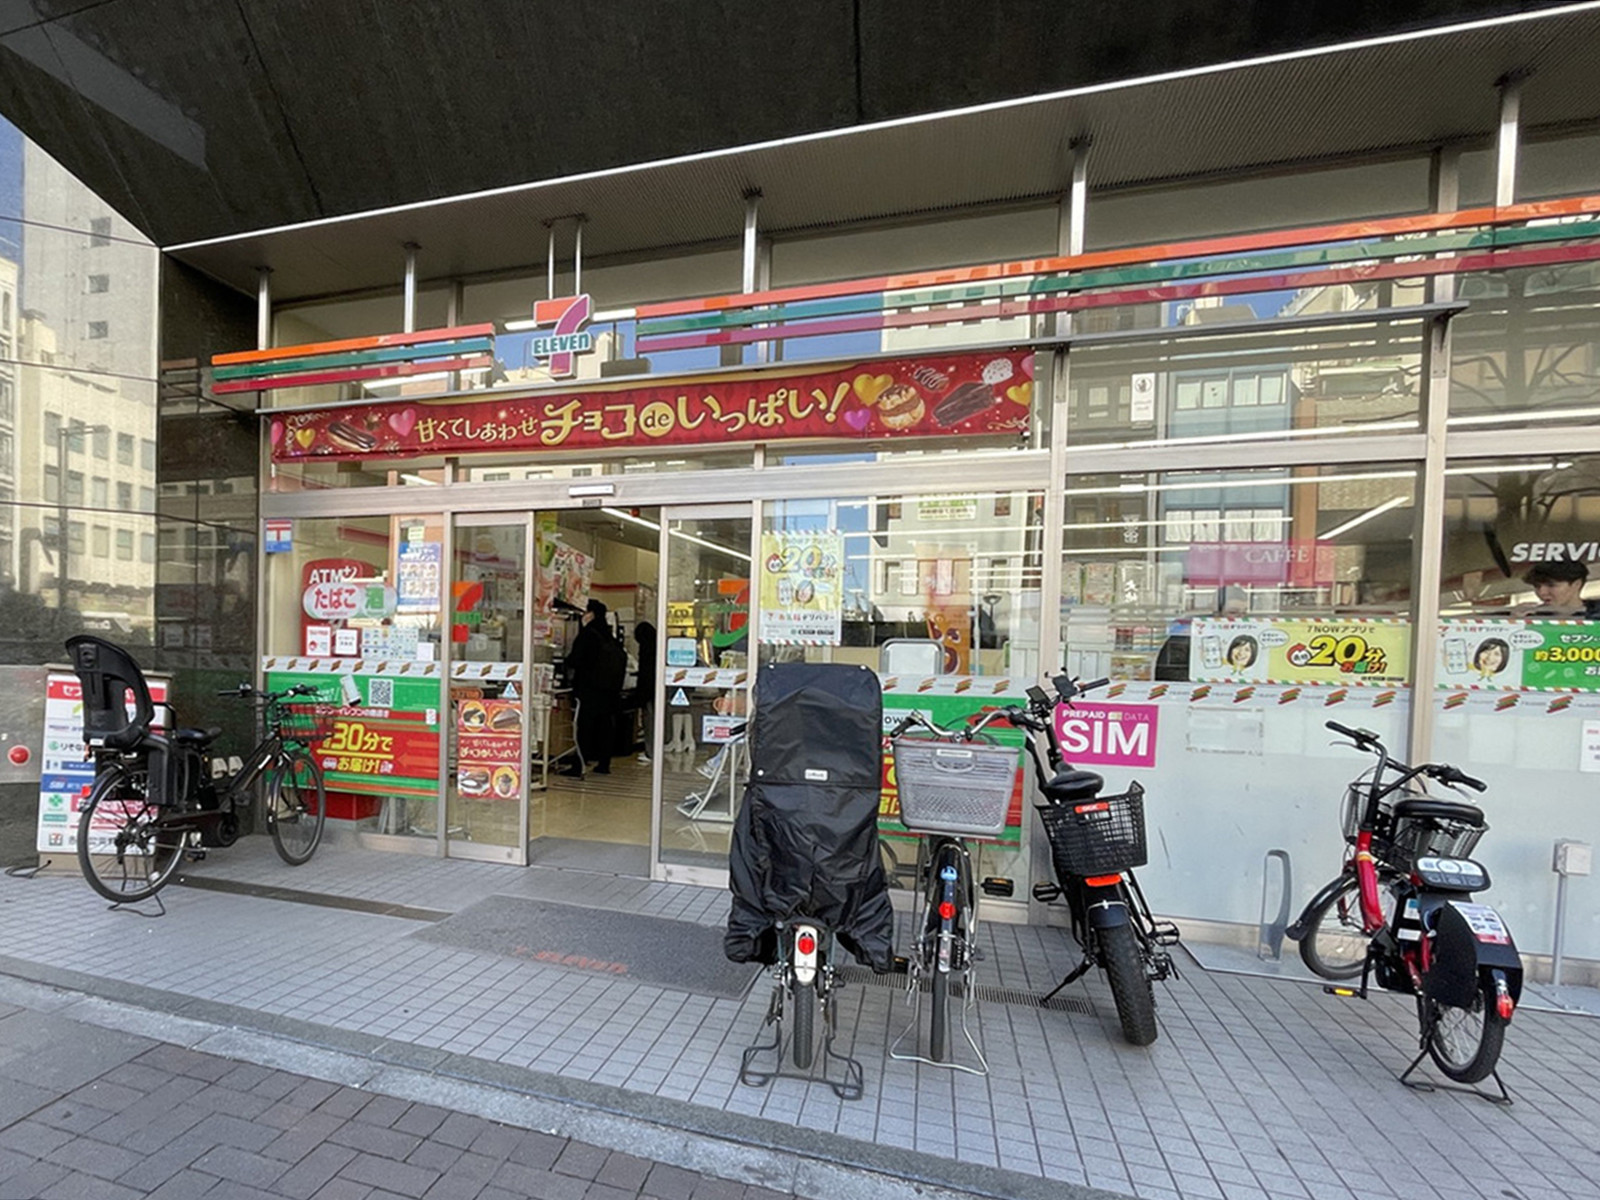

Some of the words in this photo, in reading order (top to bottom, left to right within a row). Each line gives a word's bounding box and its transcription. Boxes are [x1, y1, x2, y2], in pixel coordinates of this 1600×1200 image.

[414, 416, 538, 445] 甘くてしあわせ
[1510, 542, 1600, 562] SERVI
[314, 587, 356, 609] たばこ
[1062, 709, 1106, 719] PREPAID
[1124, 712, 1150, 722] DATA
[1060, 719, 1150, 757] SIM
[337, 757, 381, 774] お届け!
